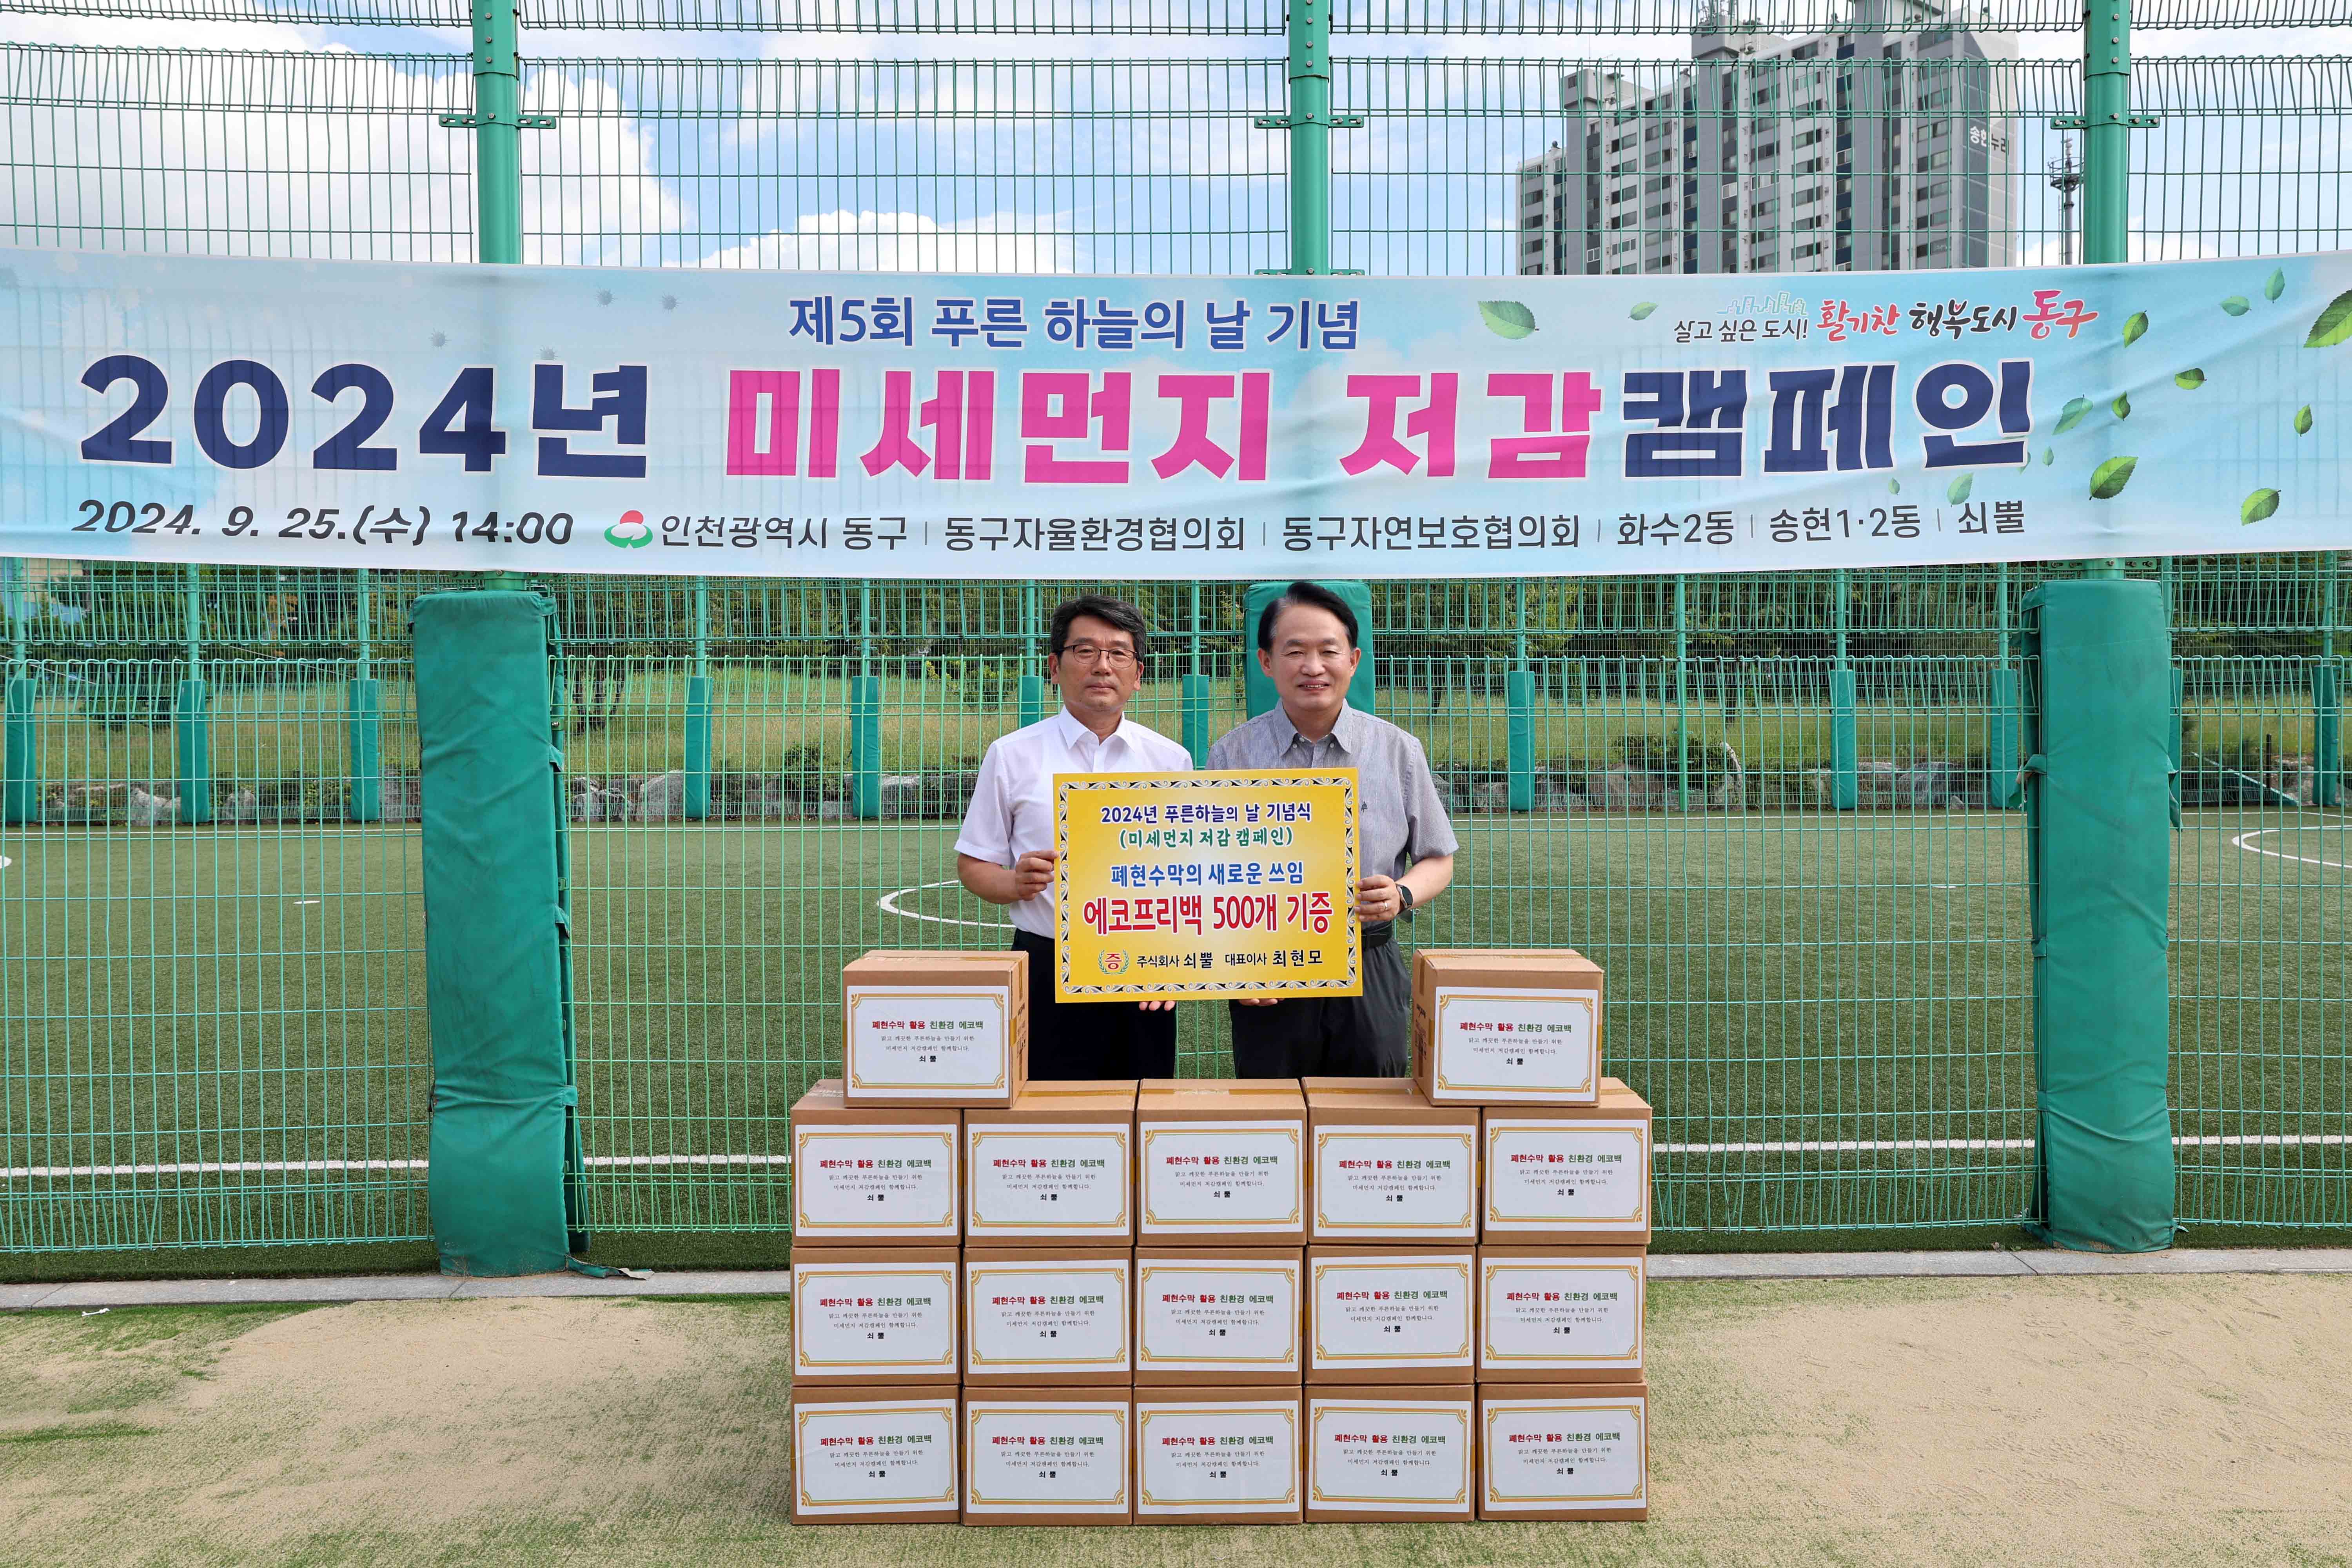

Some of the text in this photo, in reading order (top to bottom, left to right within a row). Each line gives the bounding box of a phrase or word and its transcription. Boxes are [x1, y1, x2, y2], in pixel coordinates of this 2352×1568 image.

[1674, 288, 2098, 343] 살고 싶은 도시! 활기찬 행복도시 동구
[789, 296, 1357, 350] 제5회 푸른 하늘의 날 기념
[81, 355, 2031, 483] 2024년 미세먼지 저감 캠페인
[71, 499, 573, 546] 2024. 9. 25.(수) 14:00
[662, 498, 2024, 551] 인천광역시 동구 동구자율환경협의회 동구자연보호협의회 화수2동 송현1·2동 쇠뿔
[1101, 803, 1310, 824] 2024년 푸른하늘의 날 기념식
[1120, 827, 1292, 848] (미세먼지 저감 캠페인)
[1112, 862, 1302, 887] 폐현수막의 새로운 쓰임
[1083, 892, 1333, 935] 에코프리백 500개 기증
[1104, 952, 1122, 971] 증
[1137, 955, 1179, 968] 주식회사
[1225, 953, 1267, 966] 대표이사
[1460, 1022, 1493, 1031] 폐현수막
[1498, 1023, 1514, 1031] 활용
[1518, 1024, 1542, 1032] 친환경
[1204, 1156, 1220, 1165] 활용
[1253, 1156, 1277, 1164] 에코백
[1548, 1154, 1564, 1163] 활용
[858, 1160, 873, 1168] 활용
[1377, 1160, 1392, 1169] 활용
[1080, 1296, 1103, 1304] 에코백
[1200, 1295, 1216, 1303] 활용
[1507, 1292, 1539, 1301] 폐현수막
[1544, 1292, 1560, 1301] 활용
[820, 1298, 853, 1307] 폐현수막
[821, 1437, 853, 1446] 폐현수막
[858, 1437, 874, 1445] 활용
[878, 1436, 902, 1444] 친환경
[992, 1436, 1025, 1445] 폐현수막
[1050, 1437, 1074, 1445] 친환경
[1335, 1434, 1367, 1443] 폐현수막
[1372, 1435, 1388, 1443] 활용
[1509, 1434, 1542, 1443] 폐현수막
